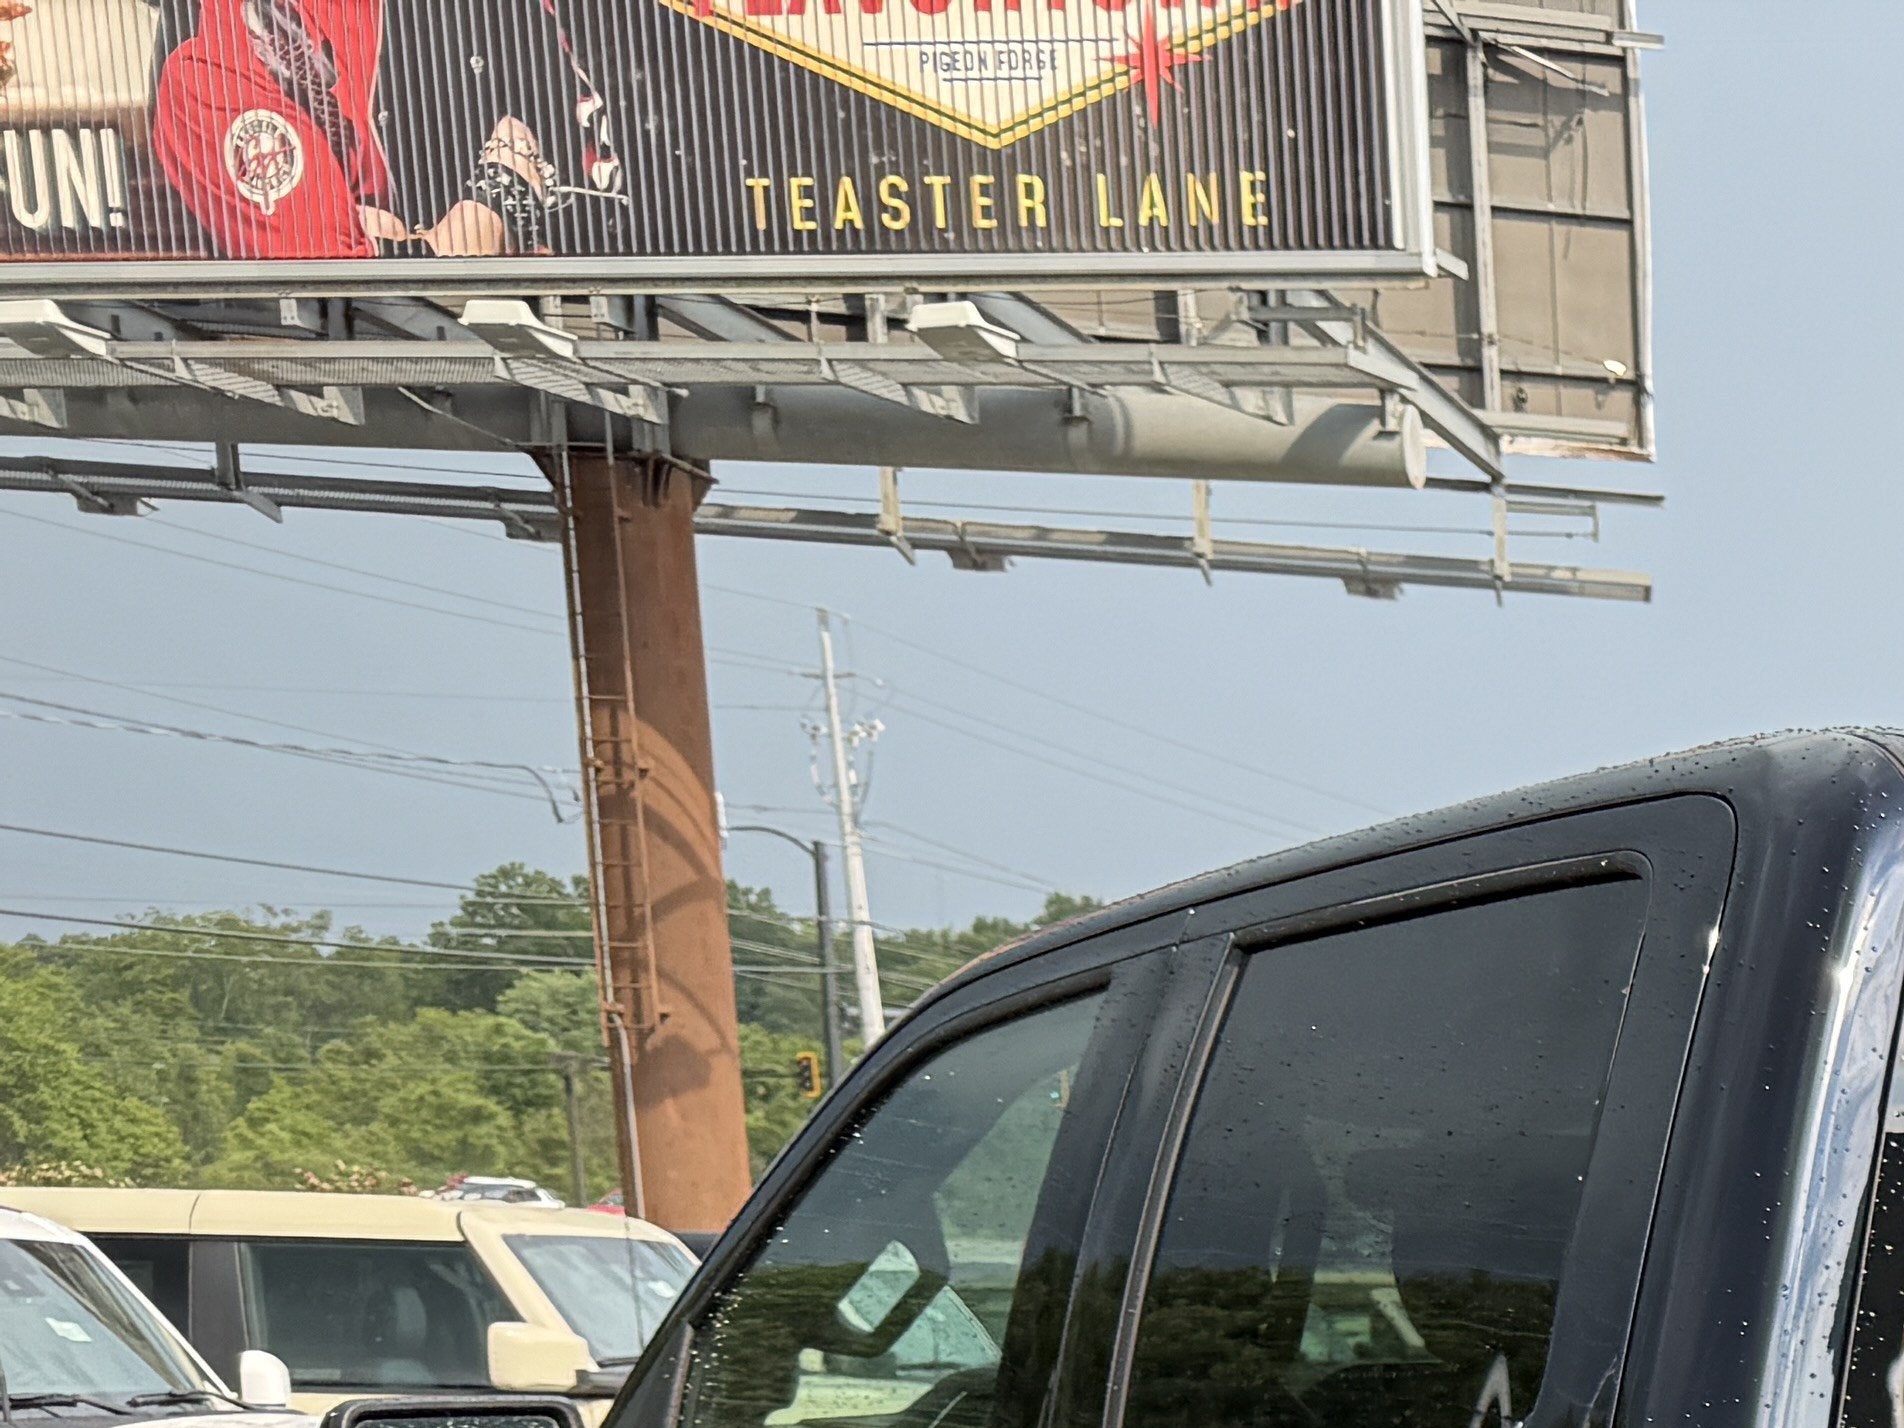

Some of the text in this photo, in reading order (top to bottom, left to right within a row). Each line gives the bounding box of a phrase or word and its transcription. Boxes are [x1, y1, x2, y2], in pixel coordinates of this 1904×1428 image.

[919, 49, 1060, 73] PIGEON FORGE
[0, 128, 123, 229] UN!
[744, 170, 1269, 233] TEASTER LANE
